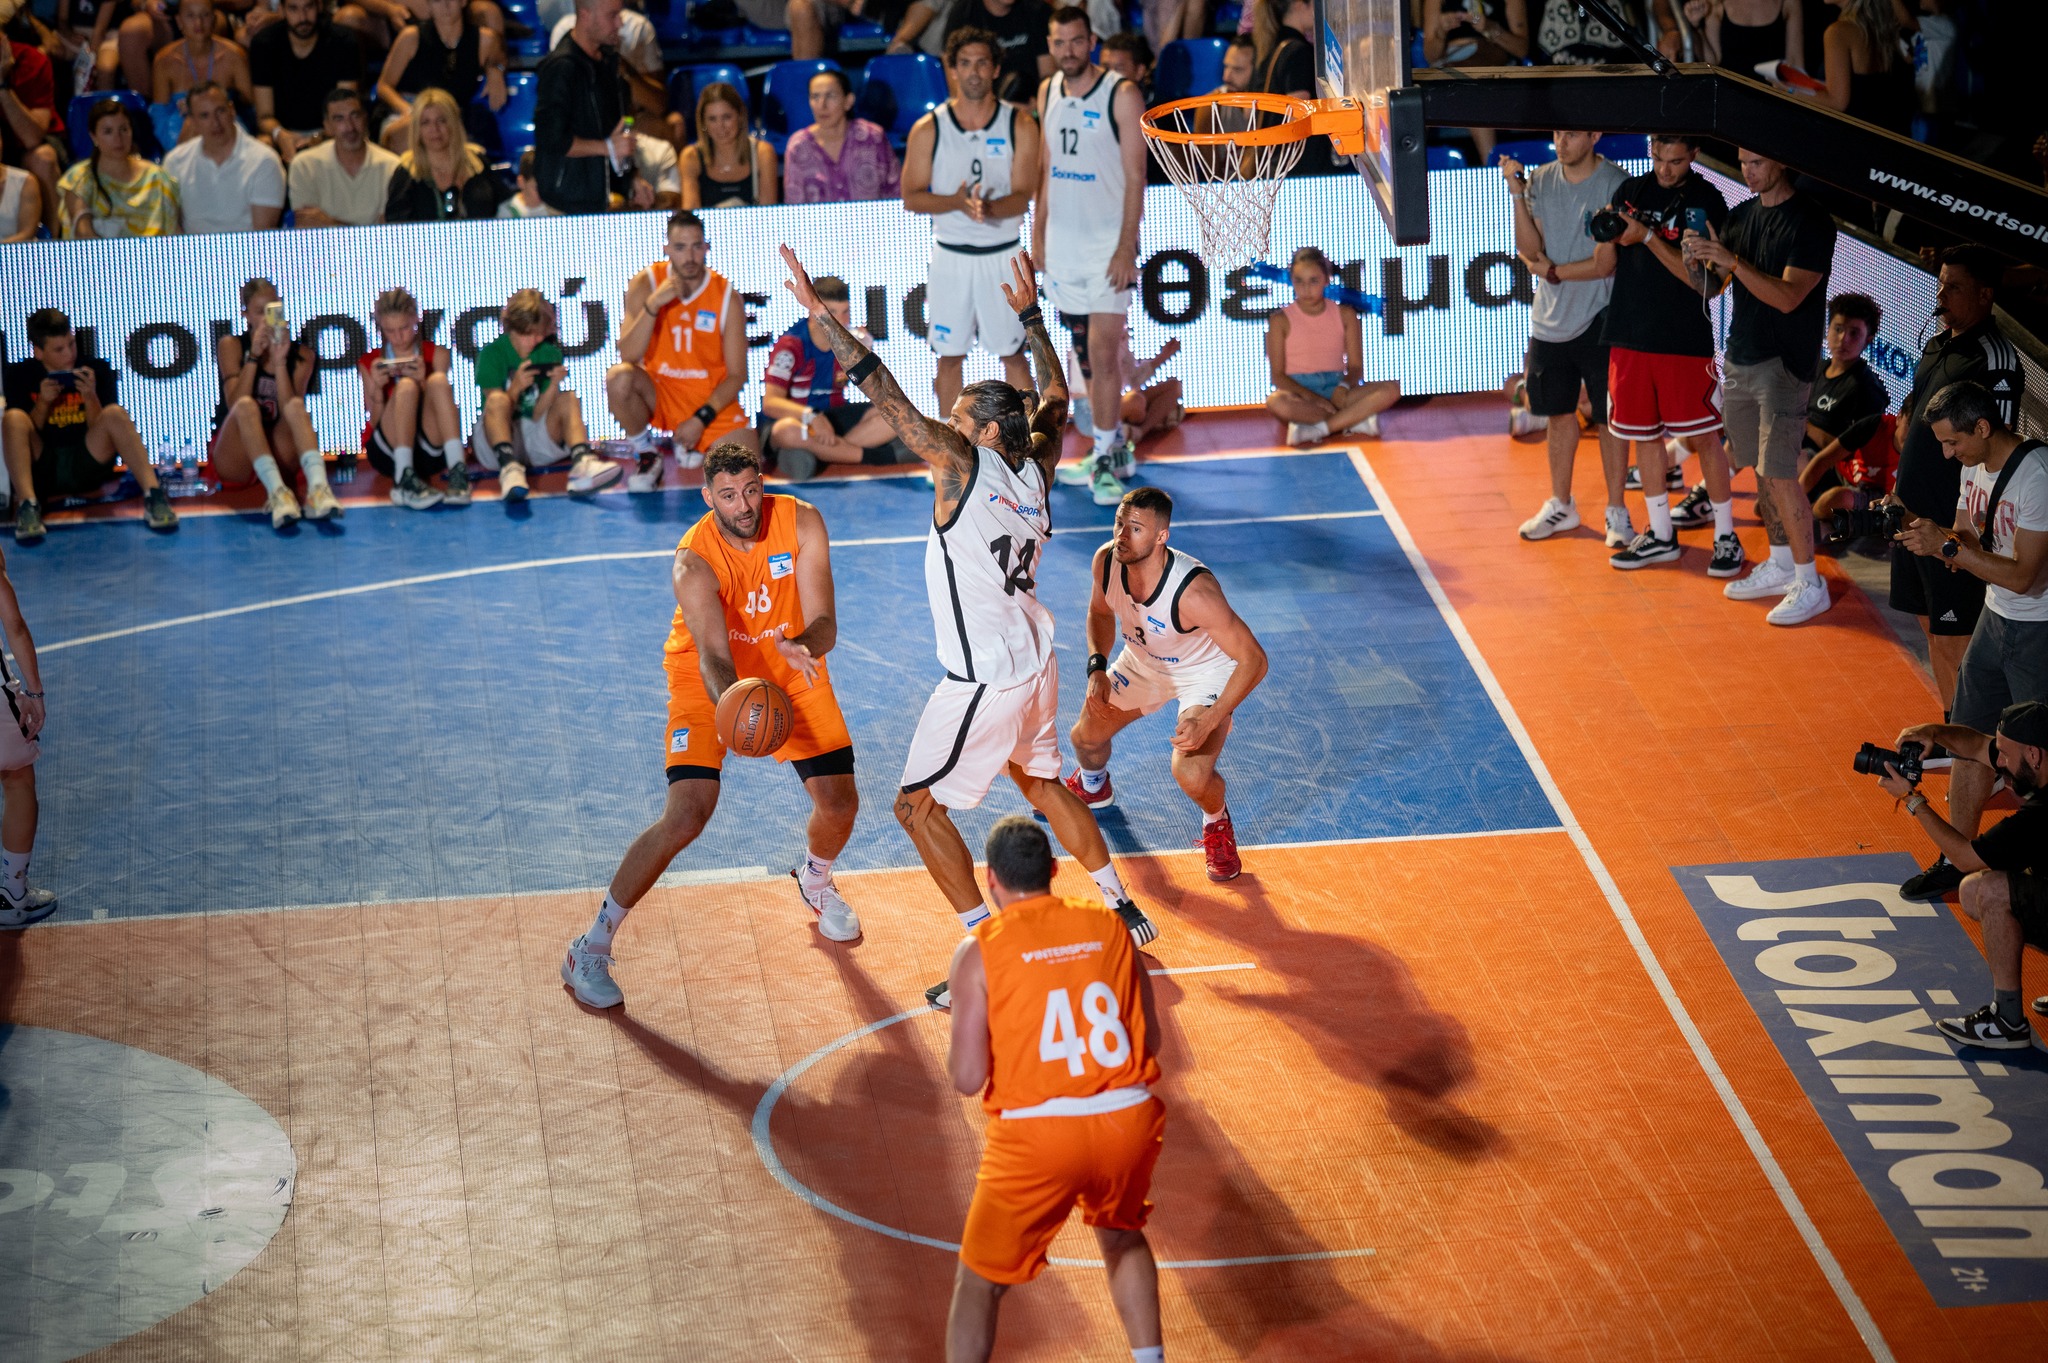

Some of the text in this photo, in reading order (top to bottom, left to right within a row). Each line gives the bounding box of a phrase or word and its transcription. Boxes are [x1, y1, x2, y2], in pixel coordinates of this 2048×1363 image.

[1060, 127, 1079, 156] 12
[968, 158, 983, 193] 9
[671, 324, 693, 354] 11
[990, 534, 1036, 597] 14
[744, 583, 772, 618] 48
[1134, 626, 1147, 646] 3
[741, 702, 764, 751] SPALDING
[1038, 980, 1132, 1078] 48
[1704, 875, 2048, 1258] Stoiximan
[1951, 1266, 1990, 1293] 21+
